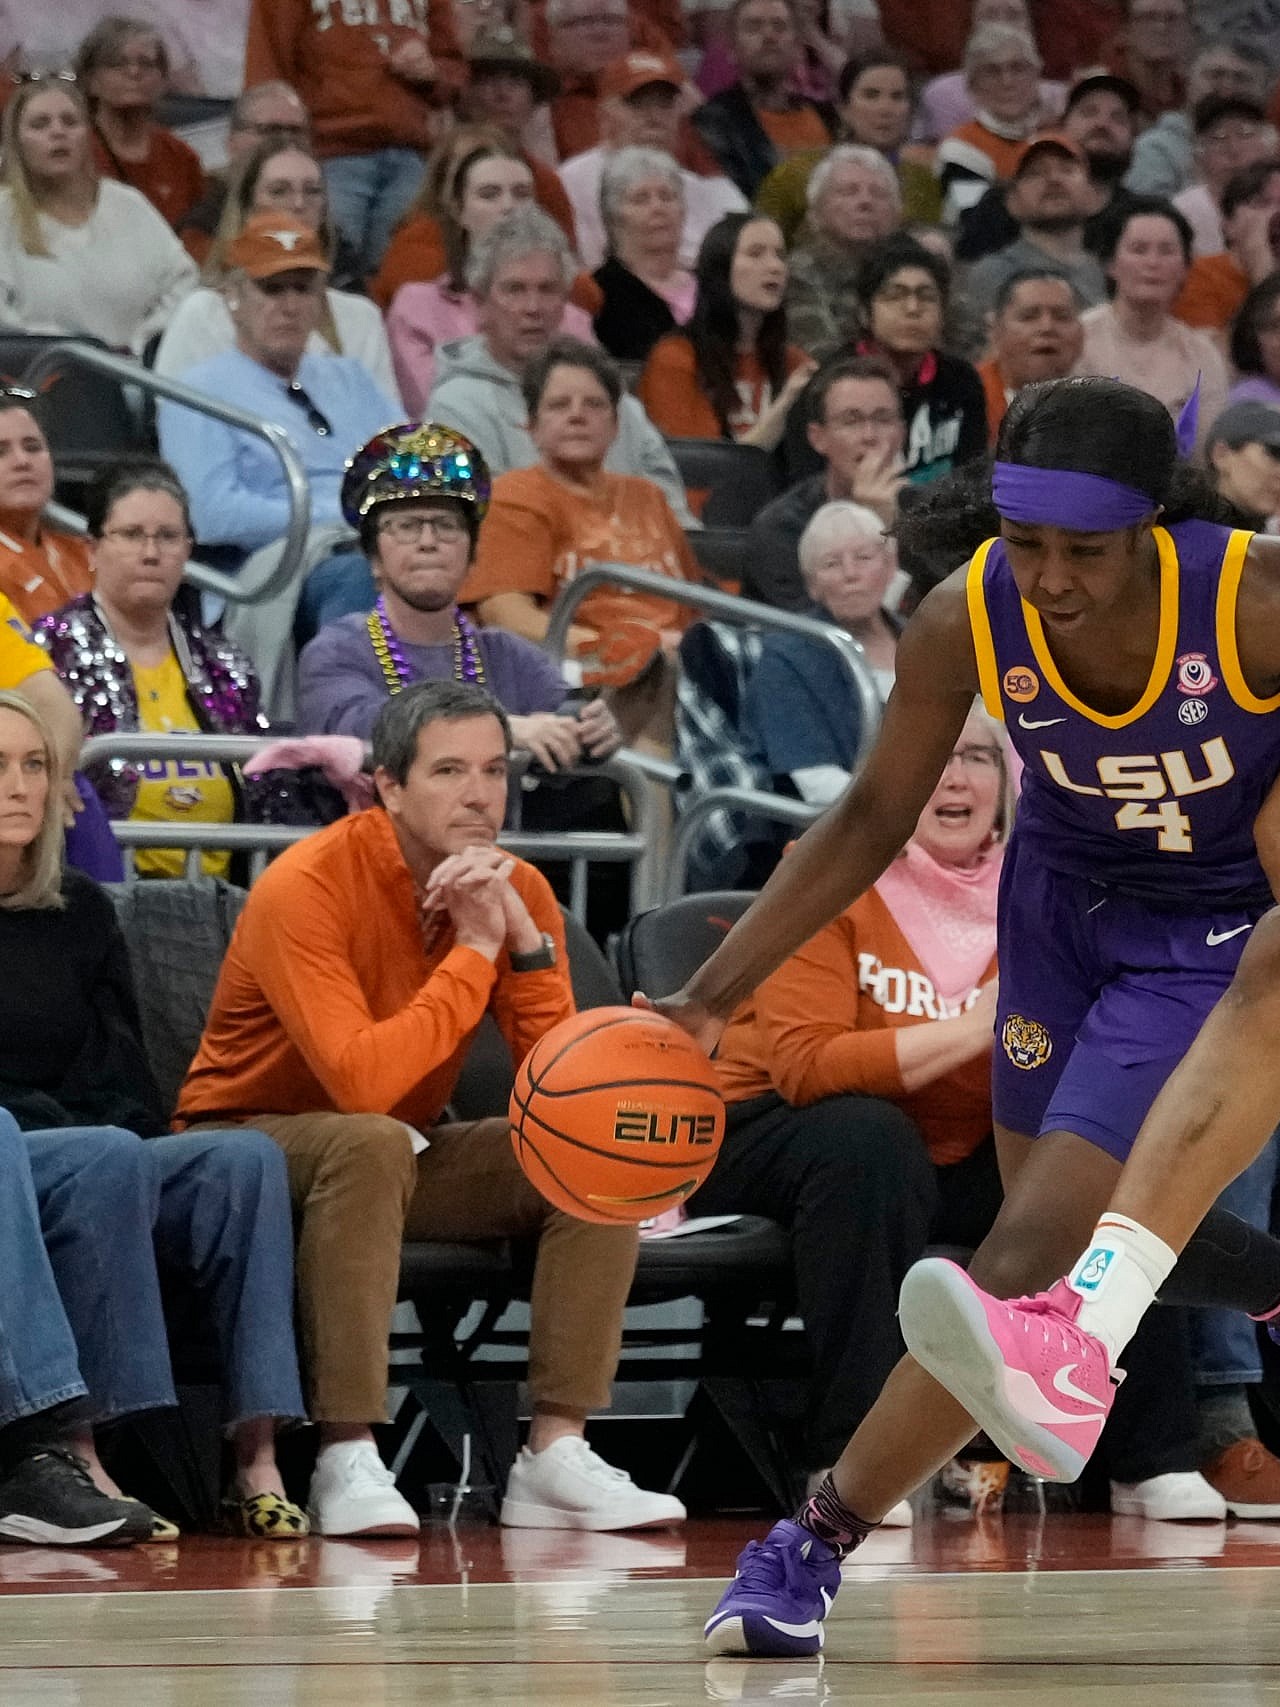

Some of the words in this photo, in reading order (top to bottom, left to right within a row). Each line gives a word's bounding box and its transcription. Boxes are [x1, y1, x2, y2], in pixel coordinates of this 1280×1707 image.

[1181, 701, 1206, 723] SEC
[1039, 735, 1236, 800] LSU
[1114, 801, 1194, 853] 4
[614, 1109, 716, 1144] ELITE
